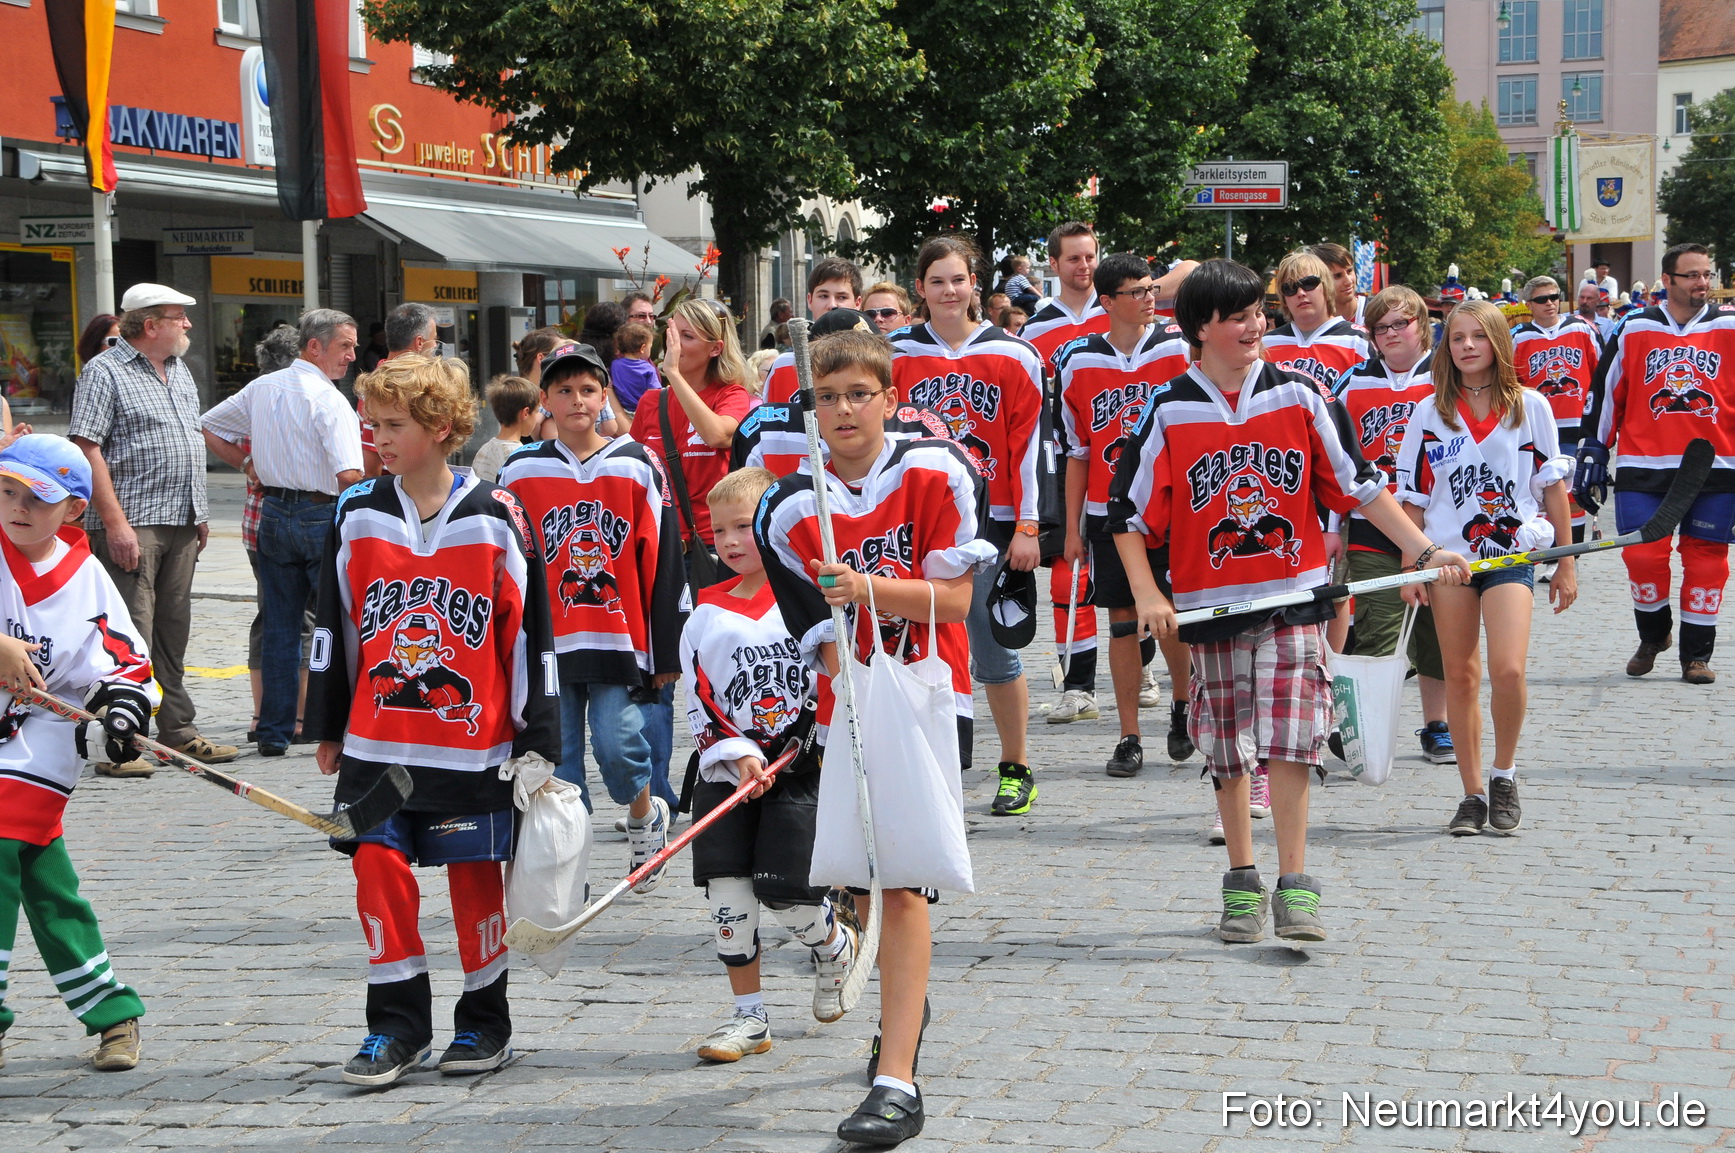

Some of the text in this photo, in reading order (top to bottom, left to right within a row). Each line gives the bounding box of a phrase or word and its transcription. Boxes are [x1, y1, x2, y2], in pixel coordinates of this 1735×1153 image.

[418, 141, 475, 166] juwelier
[1193, 168, 1267, 182] Parkleitsystem
[1202, 190, 1268, 202] P Rosengasse
[25, 224, 57, 238] NZ
[58, 230, 87, 238] ZEITUNG
[172, 231, 245, 243] NEUMARKTER
[186, 244, 232, 253] Nachrichten
[1527, 344, 1583, 379] Eagles
[1643, 344, 1722, 385] Eagles
[908, 371, 1001, 422] Eagles
[1091, 381, 1158, 432] Eagl
[1185, 441, 1304, 512] Eagles
[360, 576, 493, 650] Eagles
[1688, 587, 1722, 613] 33
[731, 636, 802, 670] Young
[428, 821, 477, 830] SYNERGY
[477, 911, 502, 963] 10
